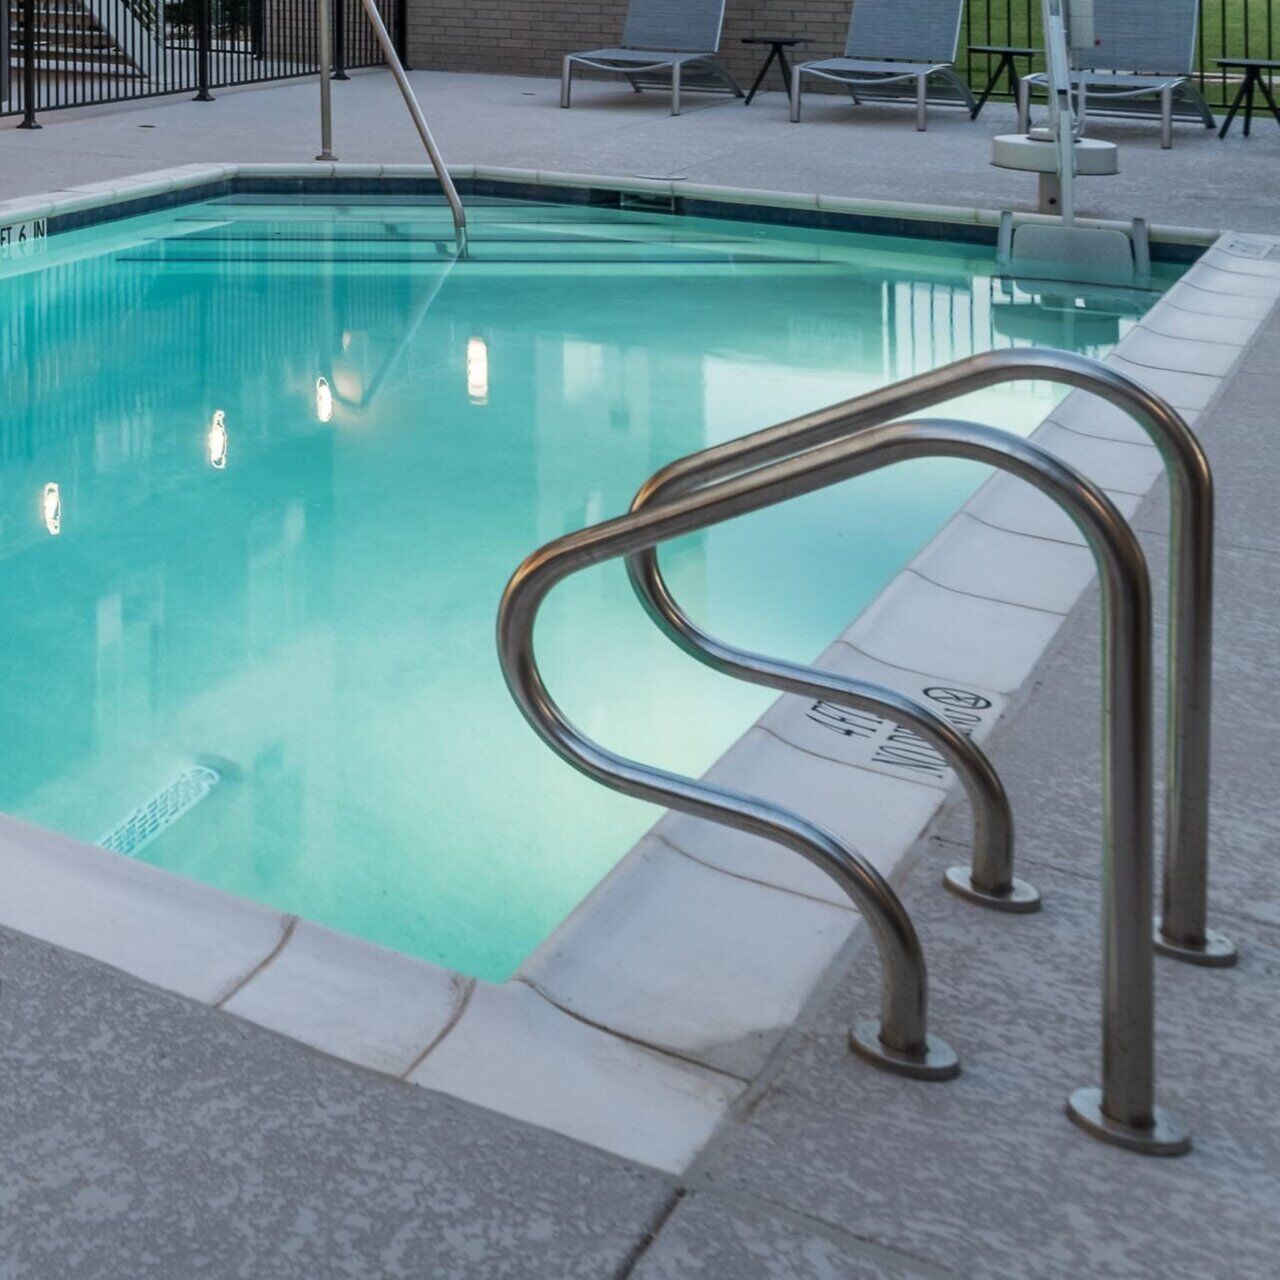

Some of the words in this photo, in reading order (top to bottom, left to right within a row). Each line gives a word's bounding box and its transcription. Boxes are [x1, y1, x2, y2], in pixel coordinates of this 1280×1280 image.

[0, 226, 13, 246] FT
[19, 225, 27, 242] 6
[33, 220, 45, 239] IN
